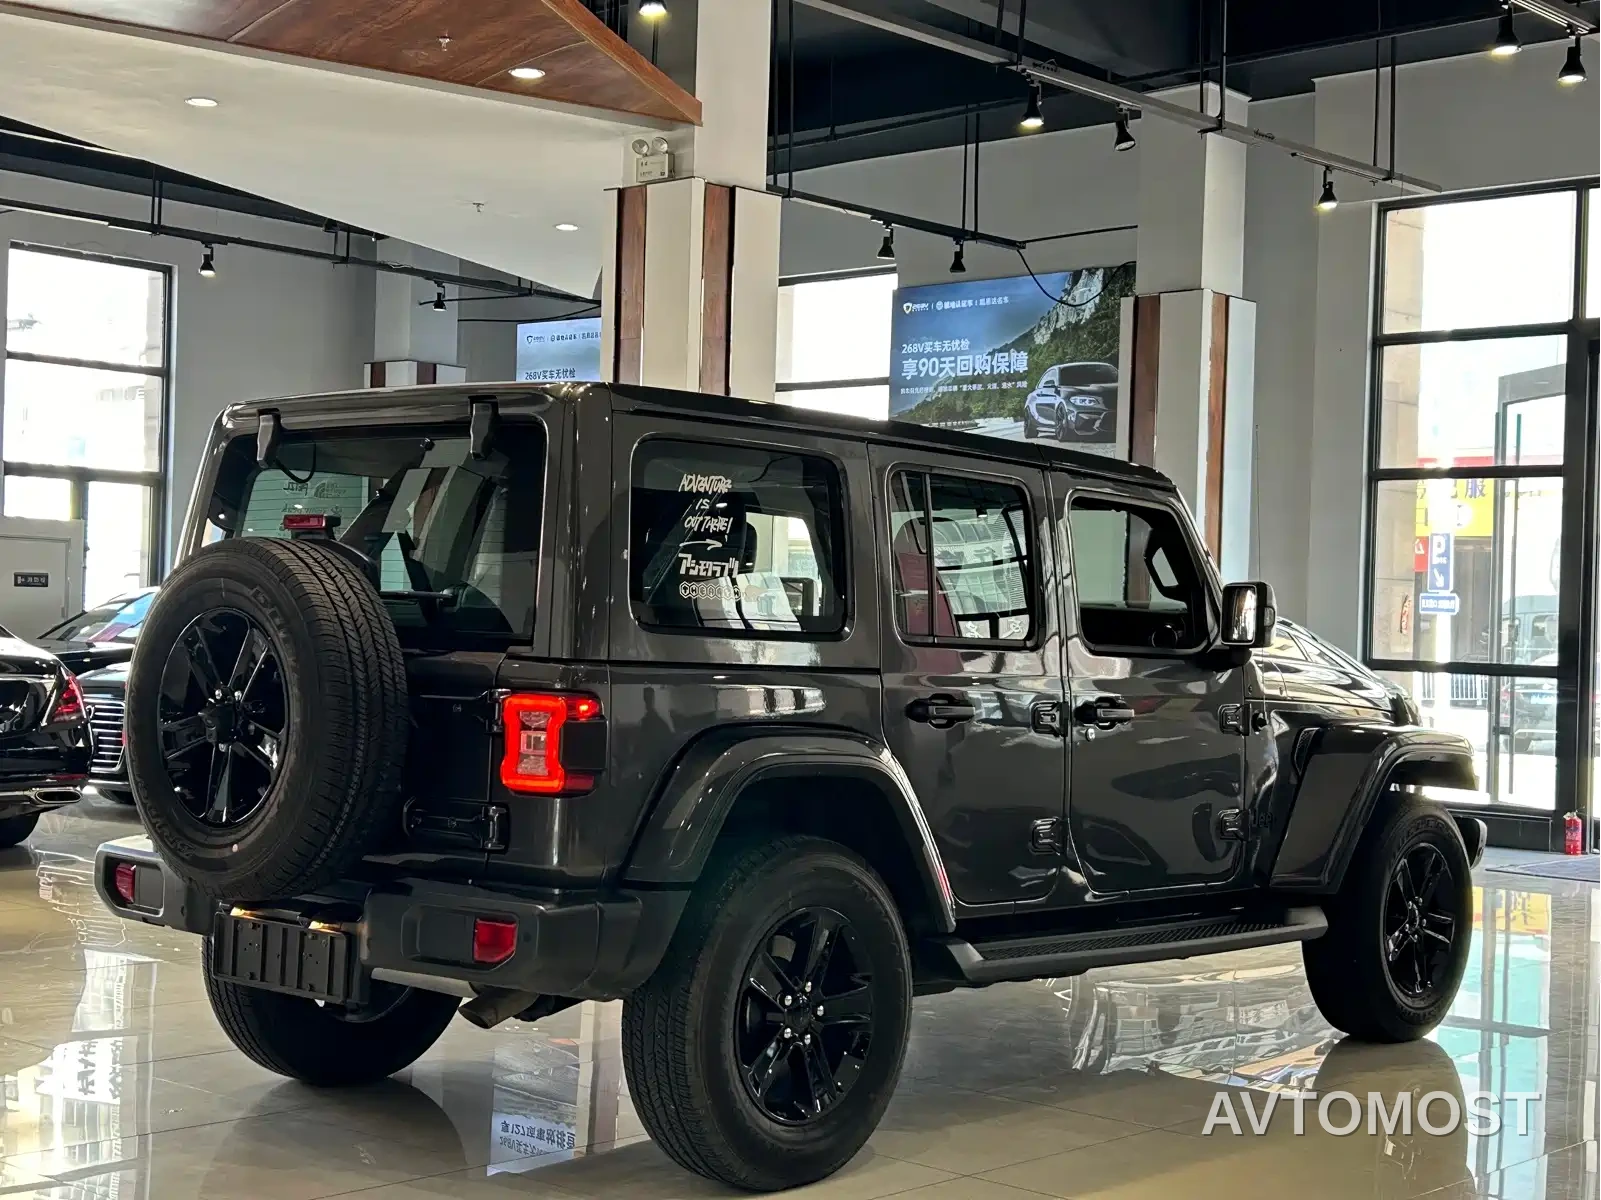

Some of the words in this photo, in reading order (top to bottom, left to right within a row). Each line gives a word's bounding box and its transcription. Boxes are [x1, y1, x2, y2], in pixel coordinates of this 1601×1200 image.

[902, 339, 970, 354] 268V买车无忧检
[902, 350, 1028, 380] 享90天回购保障
[525, 367, 576, 381] 268V买车无忧检
[678, 473, 732, 494] ADVENTURE
[695, 498, 710, 510] IS
[684, 516, 703, 532] OUT
